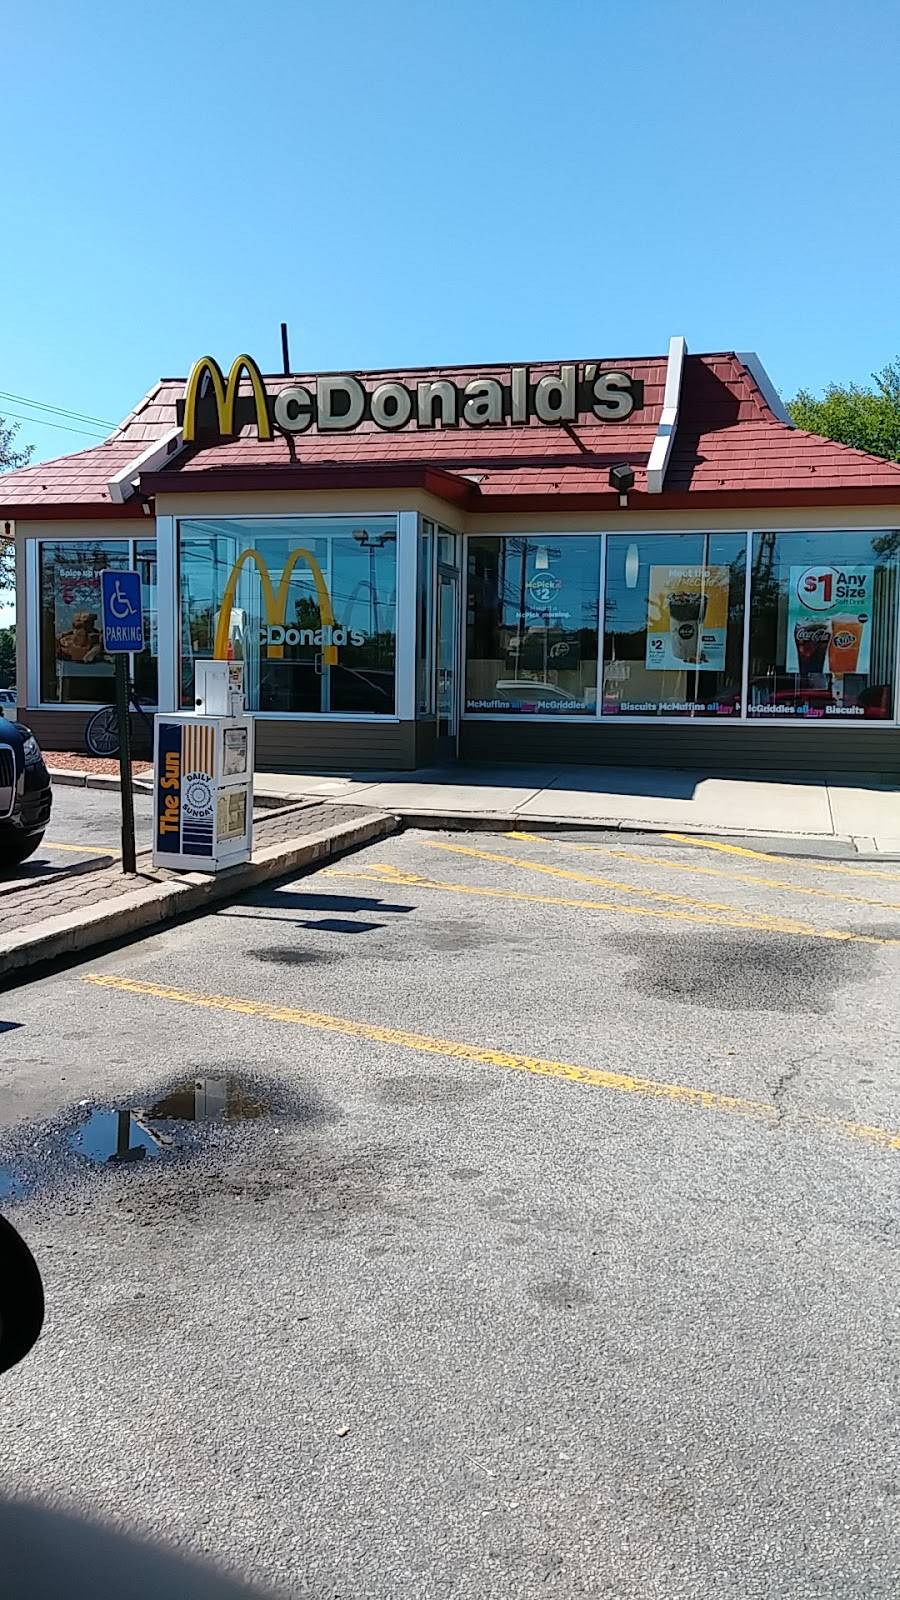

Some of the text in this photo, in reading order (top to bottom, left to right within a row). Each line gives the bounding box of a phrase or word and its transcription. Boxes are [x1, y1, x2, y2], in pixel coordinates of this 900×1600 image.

[183, 354, 634, 441] McDonald's
[804, 572, 867, 602] $1 Any
[836, 586, 867, 598] Size
[536, 588, 550, 600] $2
[105, 626, 142, 641] PARKING
[232, 624, 366, 647] McDonald's
[651, 639, 663, 650] $2
[467, 700, 510, 709] McMuffins
[537, 701, 586, 710] McGriddles
[620, 702, 657, 711] Biscuits
[658, 703, 706, 711] McMuffins
[825, 705, 864, 715] Biscuits
[187, 773, 211, 783] DAILY
[160, 752, 179, 835] The Sun
[182, 803, 214, 817] SUNDAY
